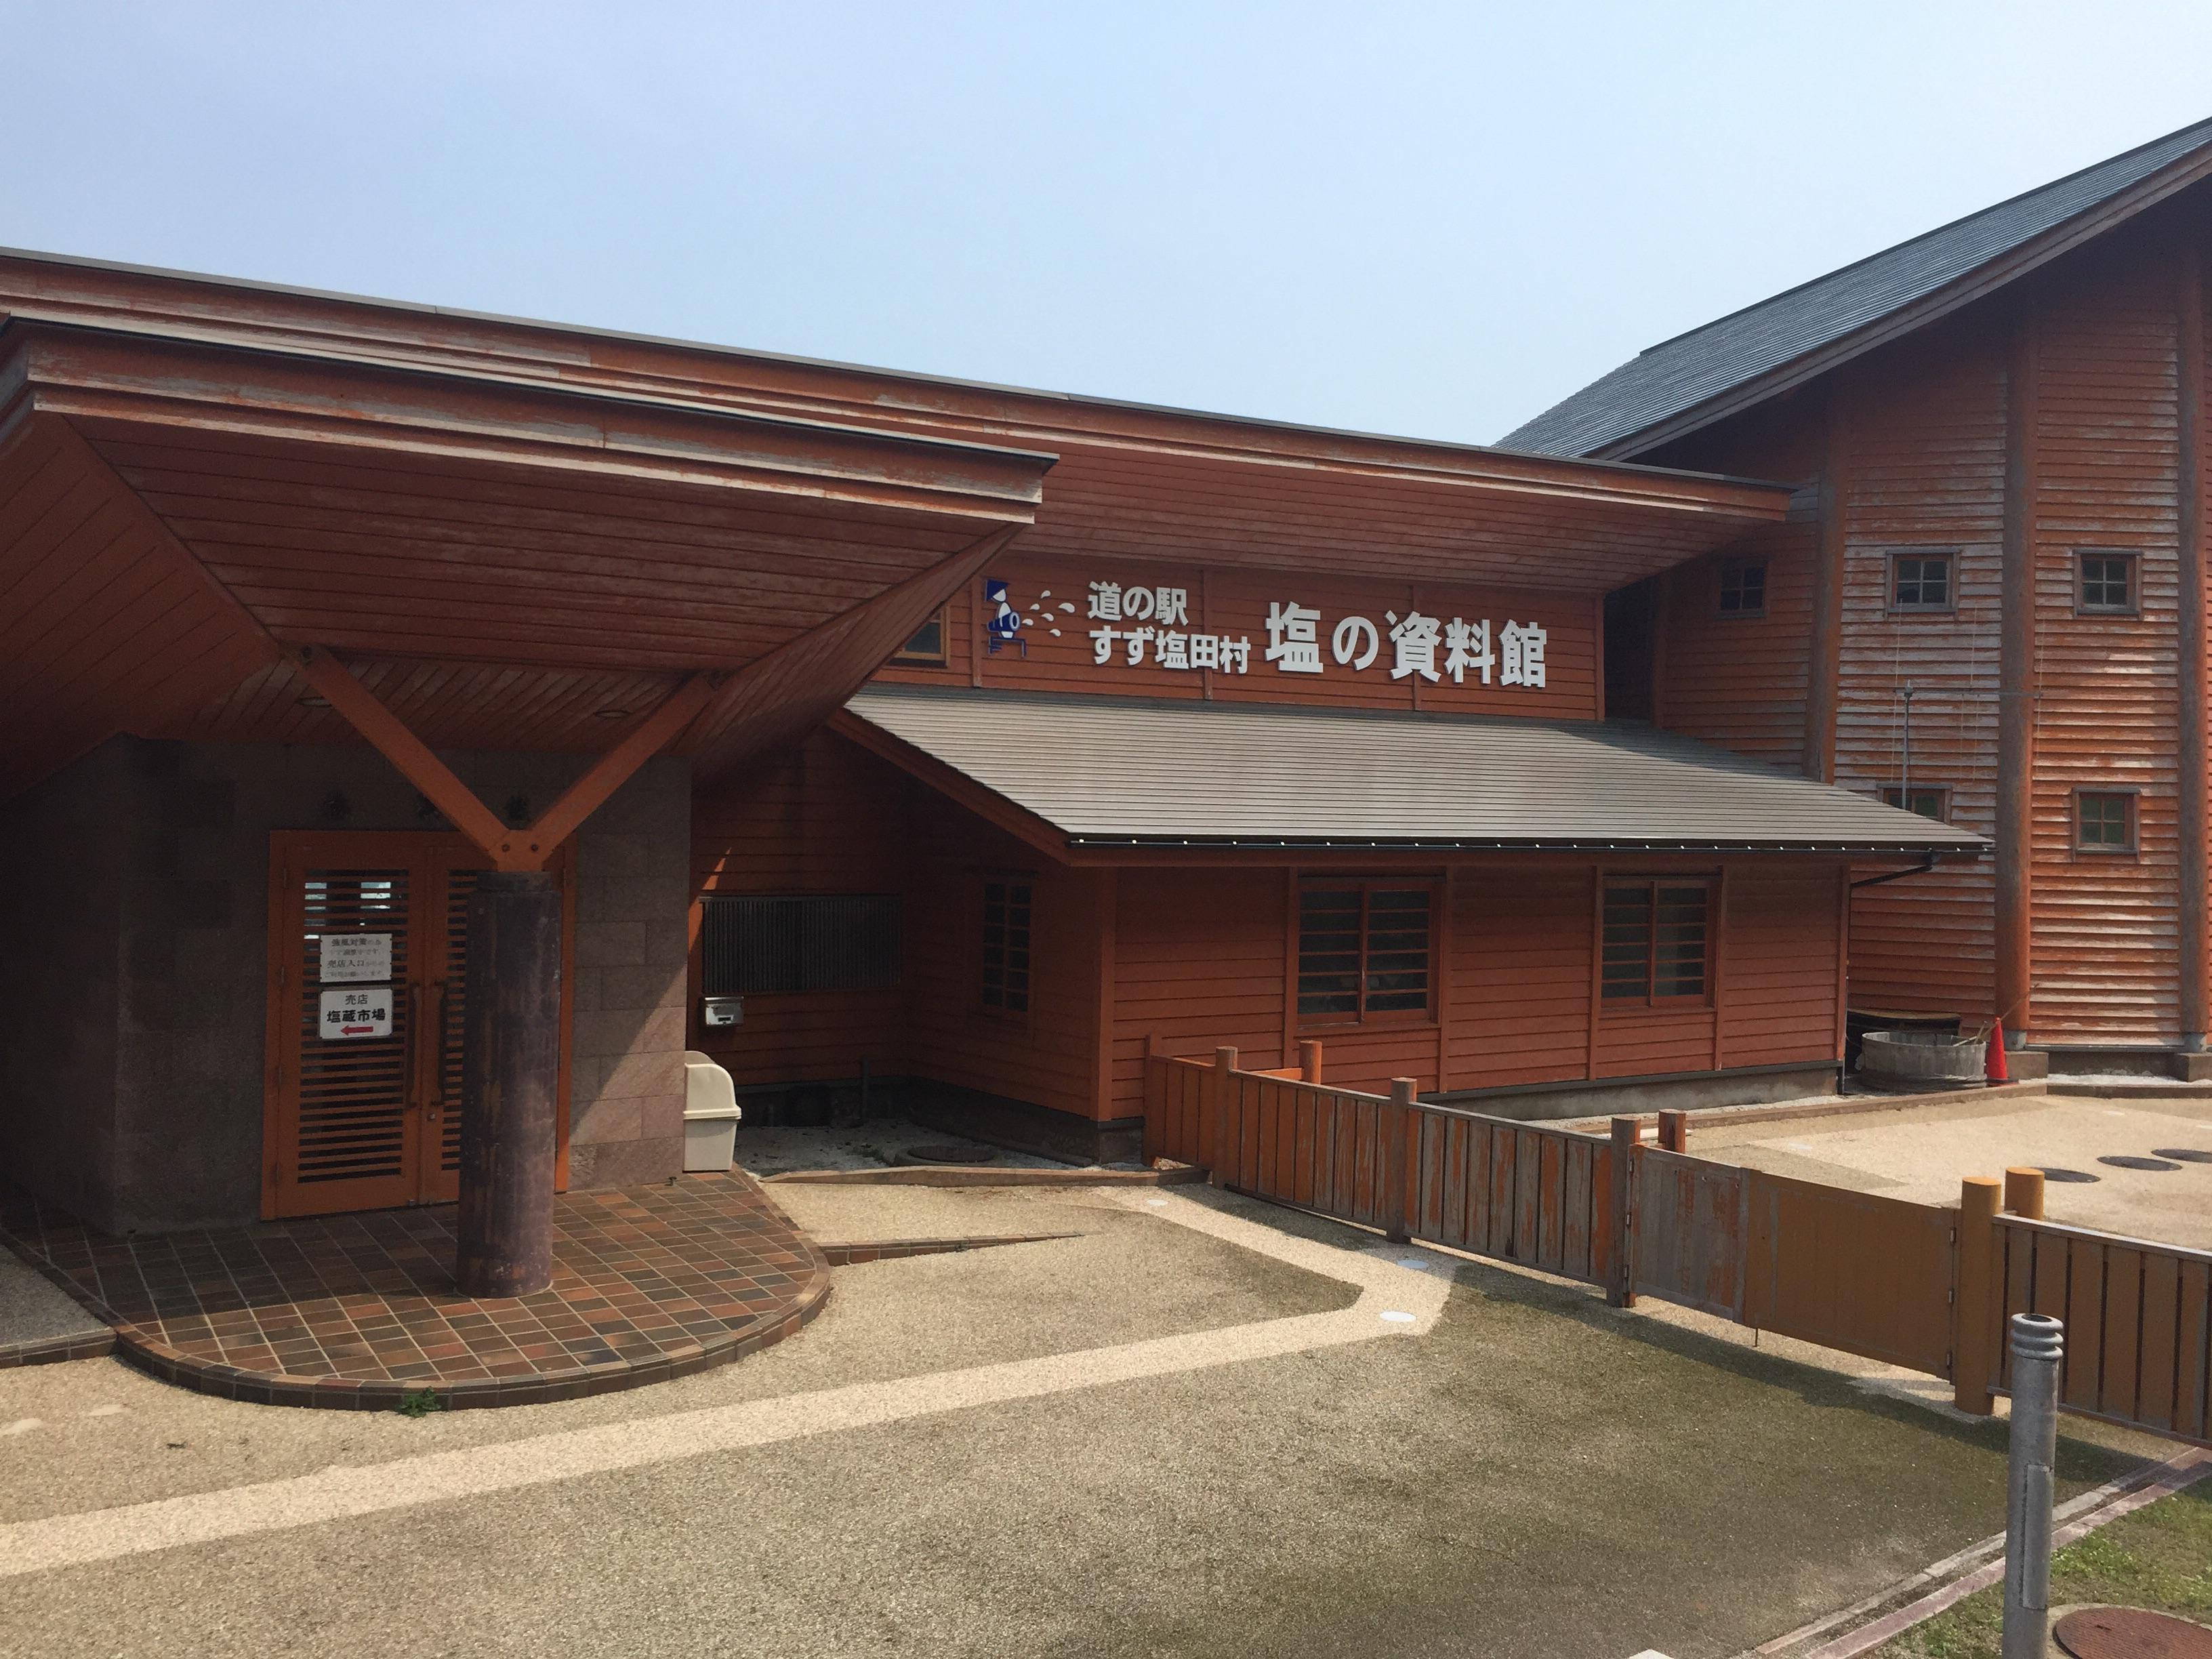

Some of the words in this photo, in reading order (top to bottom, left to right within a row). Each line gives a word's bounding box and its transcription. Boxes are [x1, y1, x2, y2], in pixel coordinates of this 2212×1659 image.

[1088, 581, 1188, 626] 道の駅
[1089, 625, 1251, 674] すず塩田村
[1265, 601, 1547, 688] 塩の資料館
[327, 1008, 386, 1023] 塩蔵市場
[344, 994, 369, 1006] 売店
